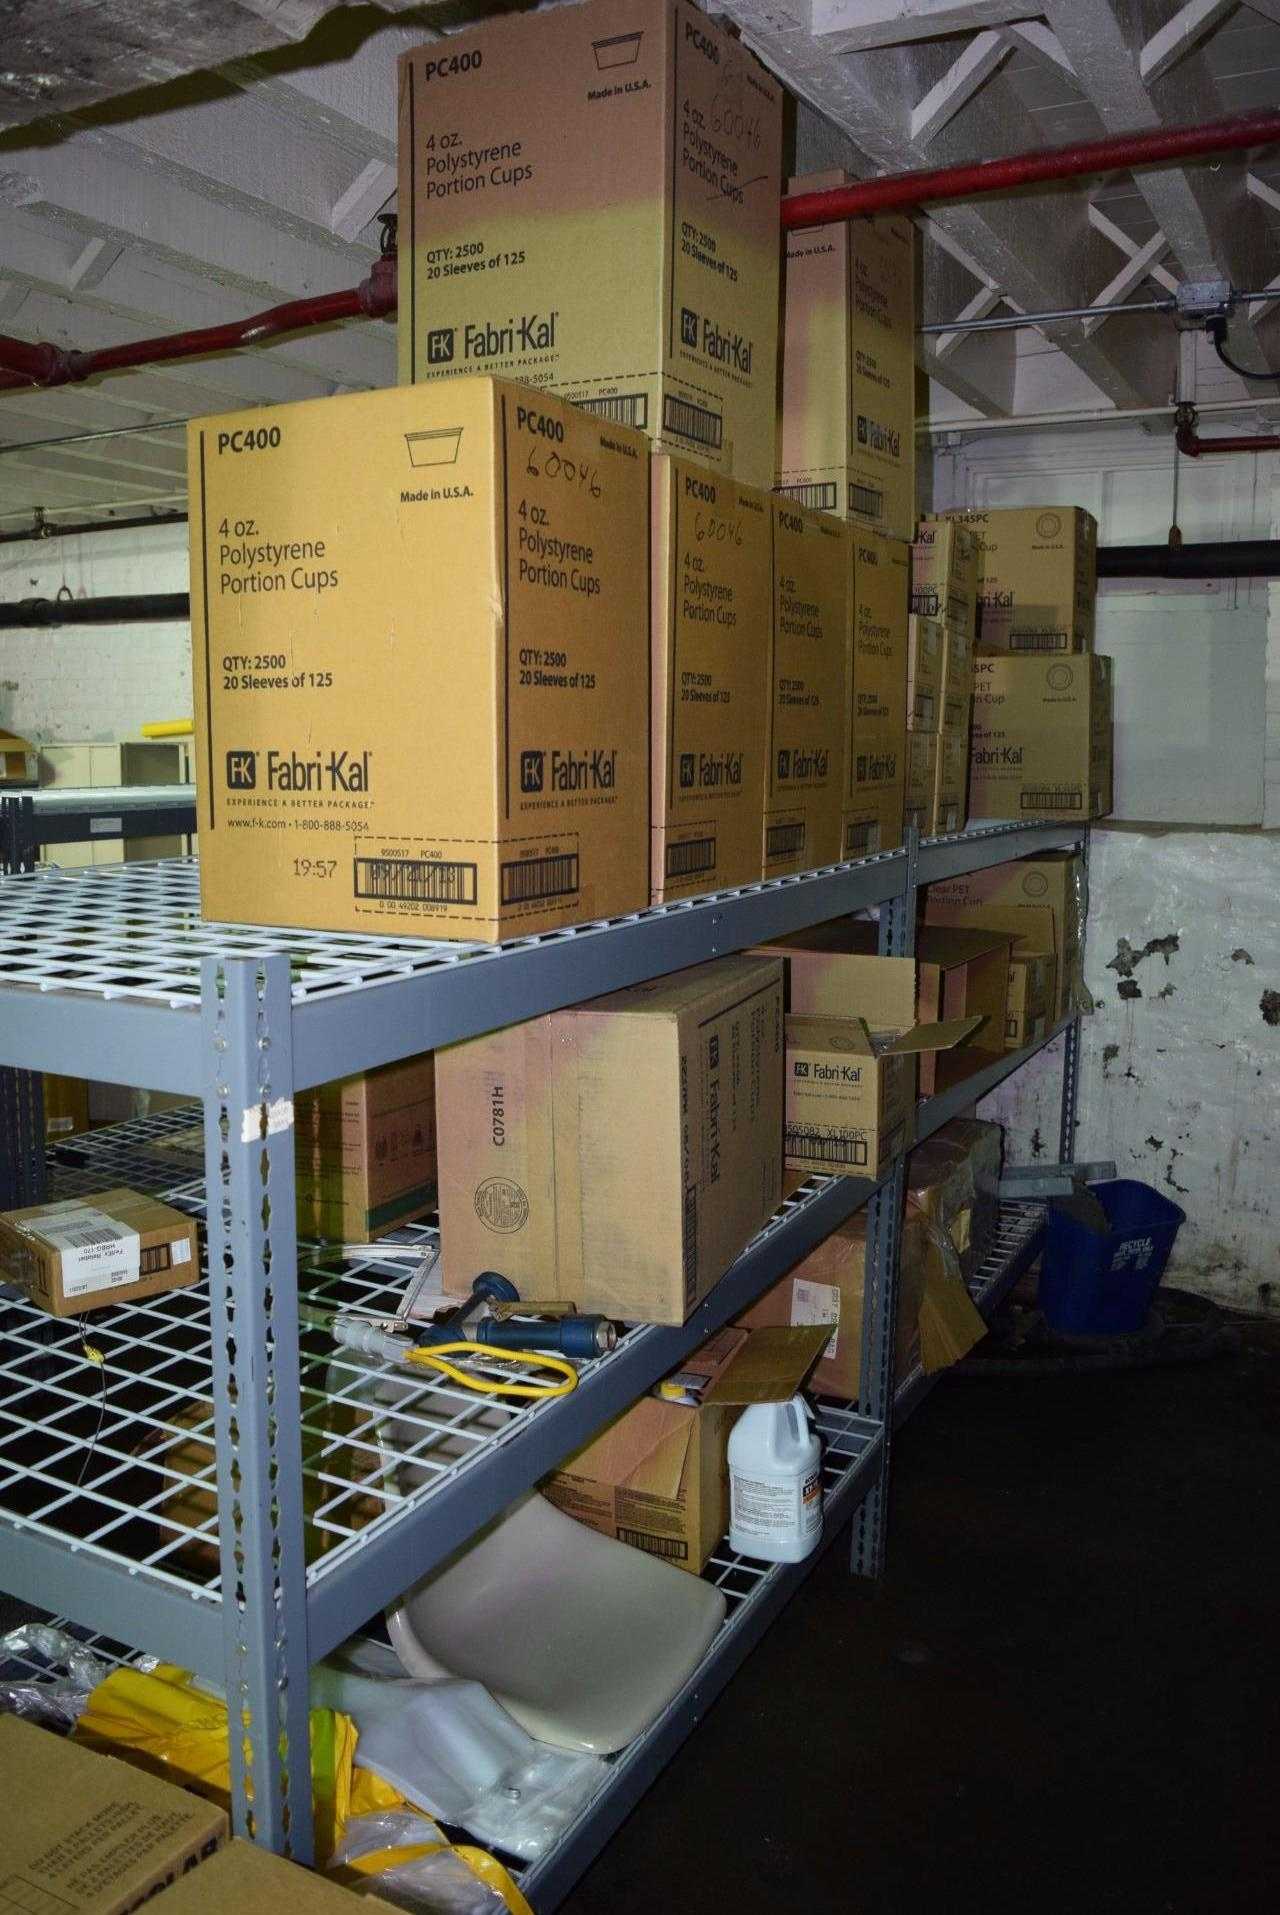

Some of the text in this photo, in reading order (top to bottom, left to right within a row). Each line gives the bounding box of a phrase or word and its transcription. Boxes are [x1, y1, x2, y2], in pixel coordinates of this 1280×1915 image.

[685, 21, 719, 64] PC400
[425, 50, 482, 82] PC400
[588, 79, 652, 101] Made in U.S.A.
[426, 132, 463, 152] 4 oz.
[682, 122, 738, 177] Polystyrene
[426, 142, 522, 176] Polystyrene
[426, 164, 533, 200] Portion Cups
[682, 148, 745, 205] Portion Cups
[426, 242, 484, 264] QTY: 2500
[426, 250, 526, 280] 20 Sleeves of 125
[464, 312, 558, 359] Fabri-Kal
[426, 366, 473, 378] EXPERIENCE
[517, 406, 564, 444] PC400
[218, 426, 281, 454] PC400
[526, 447, 601, 498] 60046
[400, 486, 474, 503] Made in U.S.A.
[685, 473, 716, 504] PC400
[518, 498, 550, 526] 4 oz.
[778, 510, 803, 534] PC400
[218, 518, 260, 538] 4 oz.
[220, 538, 326, 570] Polystyrene
[518, 527, 593, 564] Polystyrene
[684, 552, 691, 567] 4
[220, 567, 338, 596] Portion Cups
[520, 560, 600, 599] Portion Cups
[683, 574, 733, 602] Polystyrene
[683, 602, 737, 629] Portion Cups
[222, 654, 286, 671] QTY: 2500
[518, 648, 566, 668] QTY: 2500
[223, 672, 333, 690] 20 Sleeves of 125
[520, 670, 595, 689] 20 Sleeves of 125
[228, 750, 371, 792] FK Fabri-Kal
[551, 750, 616, 792] Fabri-Kal
[226, 798, 278, 808] EXPERIENCE
[290, 800, 324, 808] BETTER
[227, 818, 286, 830] www.f-k.com
[293, 857, 338, 879] 19:57
[420, 848, 442, 860] PC400
[492, 1084, 506, 1147] C0781H
